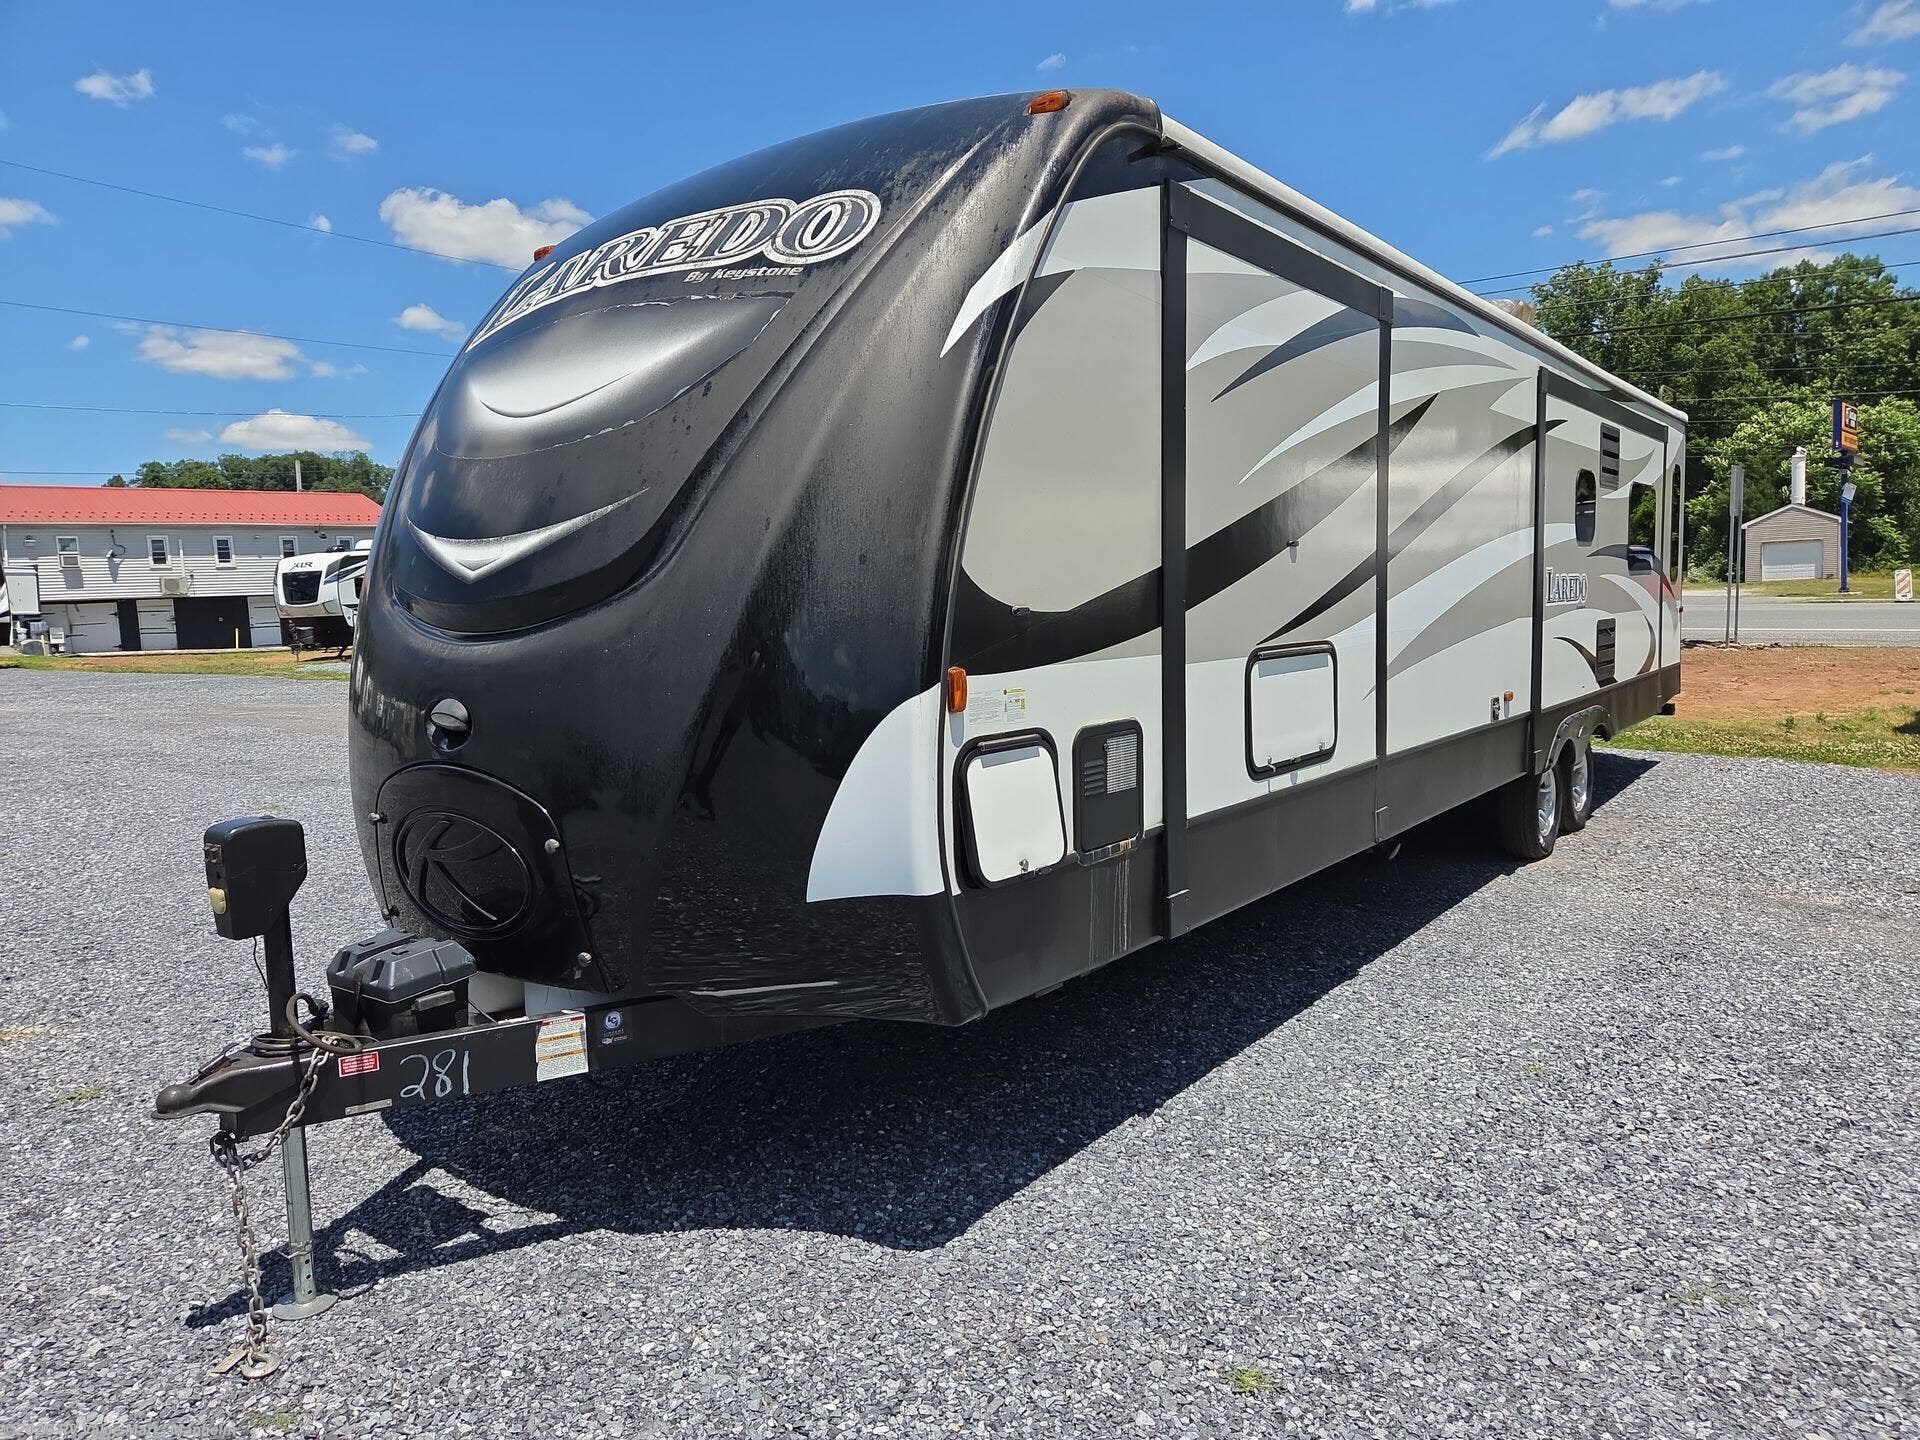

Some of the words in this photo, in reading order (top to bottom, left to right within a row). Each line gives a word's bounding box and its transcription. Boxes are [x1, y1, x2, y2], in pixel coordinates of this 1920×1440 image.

[465, 189, 881, 352] LAREDO
[684, 270, 708, 284] By
[711, 265, 804, 282] Keystone
[290, 562, 313, 571] XLR
[1546, 567, 1588, 606] LAREDO
[399, 1049, 471, 1100] 281
